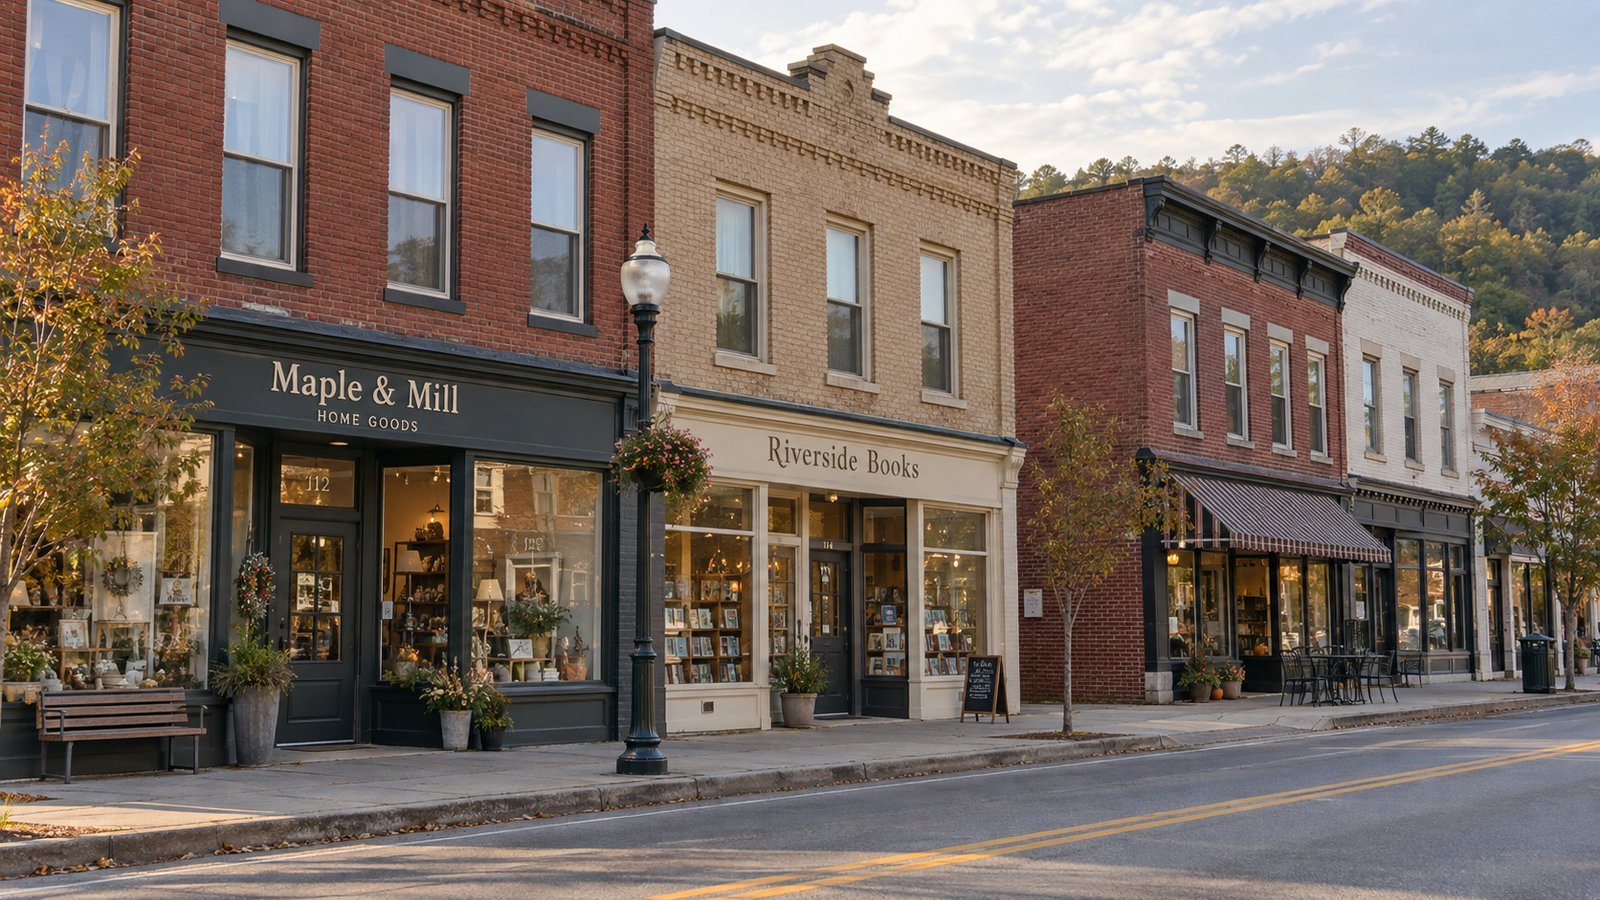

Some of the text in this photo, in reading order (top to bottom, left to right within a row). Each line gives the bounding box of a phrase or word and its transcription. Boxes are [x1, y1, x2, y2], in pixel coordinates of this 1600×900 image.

[271, 360, 459, 414] Maple & Mill
[317, 409, 418, 433] HOME GOODS
[768, 435, 919, 479] Riverside Books
[305, 475, 330, 492] 112
